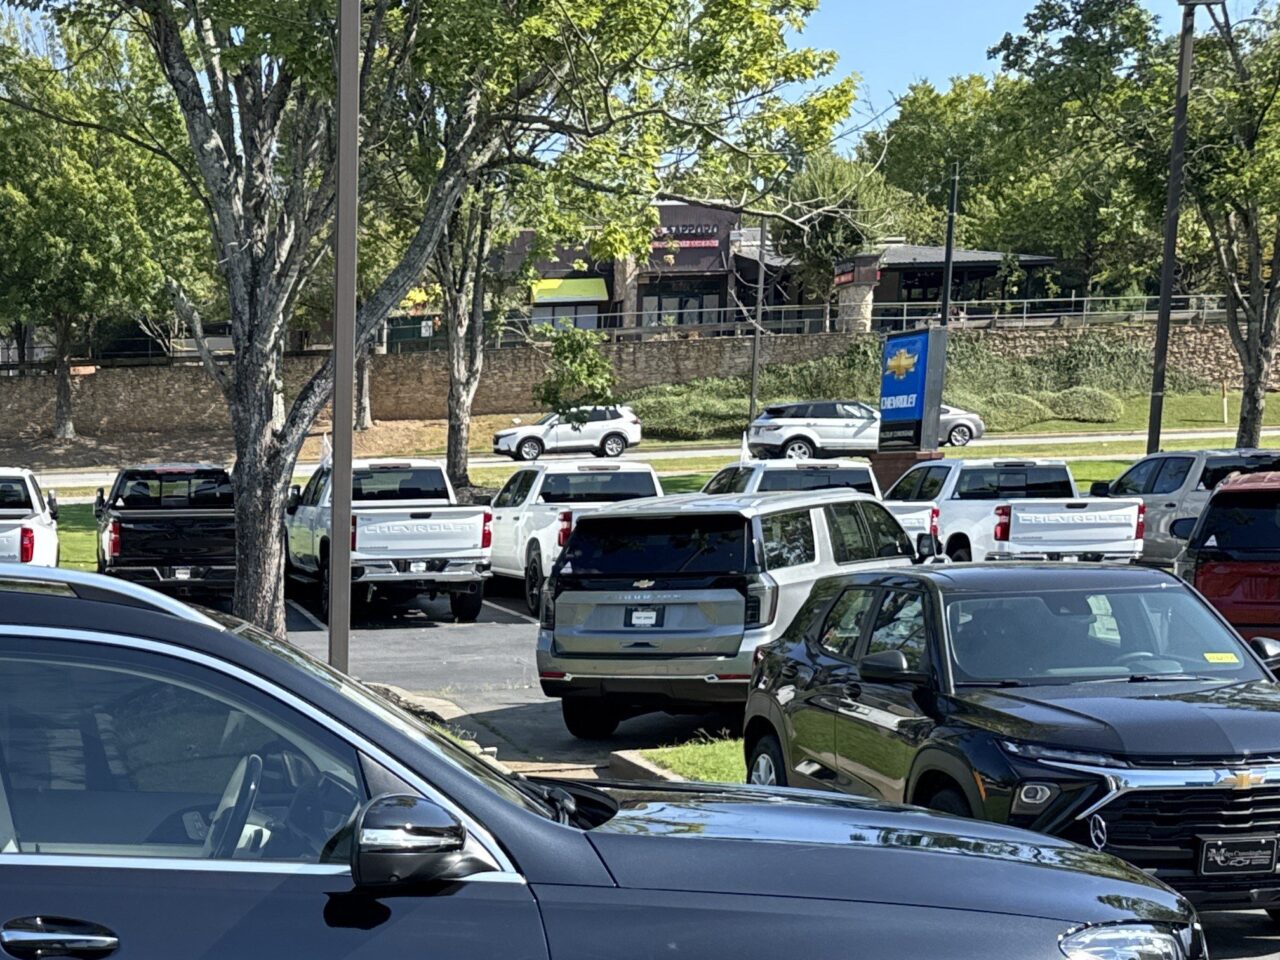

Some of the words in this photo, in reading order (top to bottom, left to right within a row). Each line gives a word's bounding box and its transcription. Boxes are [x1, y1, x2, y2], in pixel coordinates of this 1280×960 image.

[880, 394, 917, 410] CHEVROLET
[1019, 513, 1131, 524] CHEVROLET
[364, 523, 474, 534] CHEVROLET
